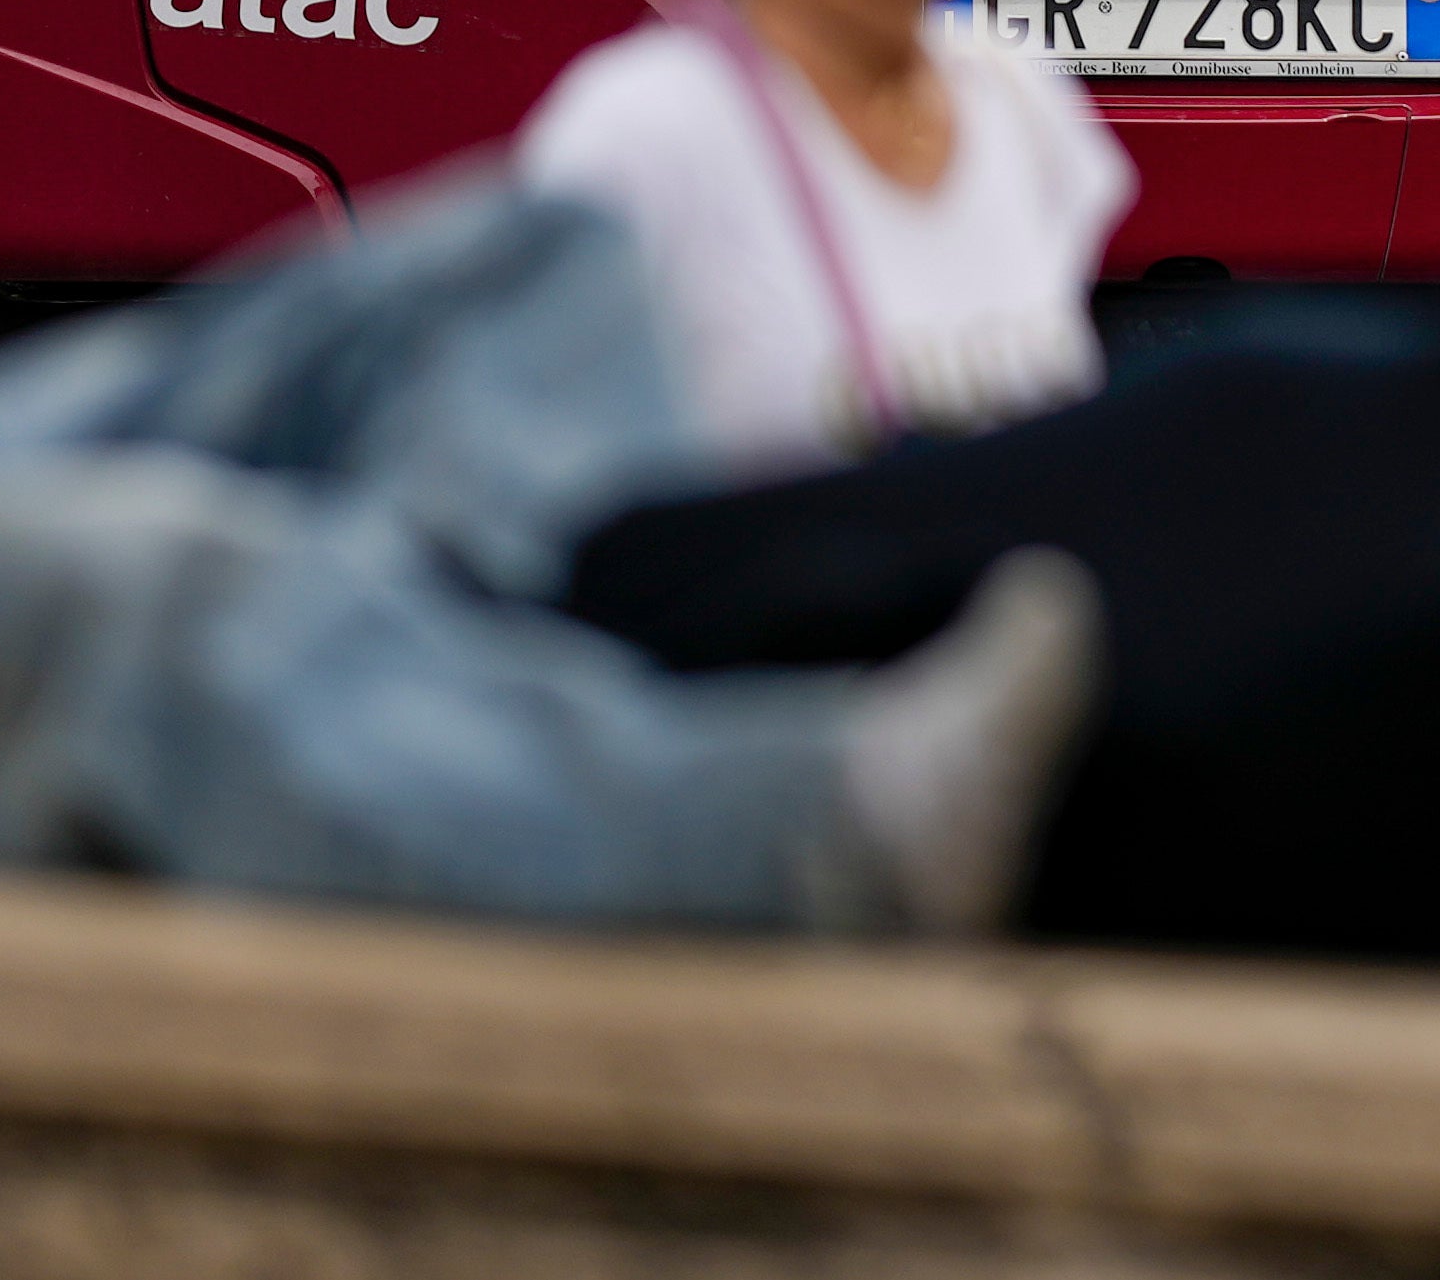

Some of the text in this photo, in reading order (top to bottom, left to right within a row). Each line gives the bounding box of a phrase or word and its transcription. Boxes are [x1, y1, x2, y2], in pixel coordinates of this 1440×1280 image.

[1111, 61, 1147, 75] Benz
[1172, 62, 1252, 75] Omnibusse
[1277, 62, 1356, 75] Mannheim
